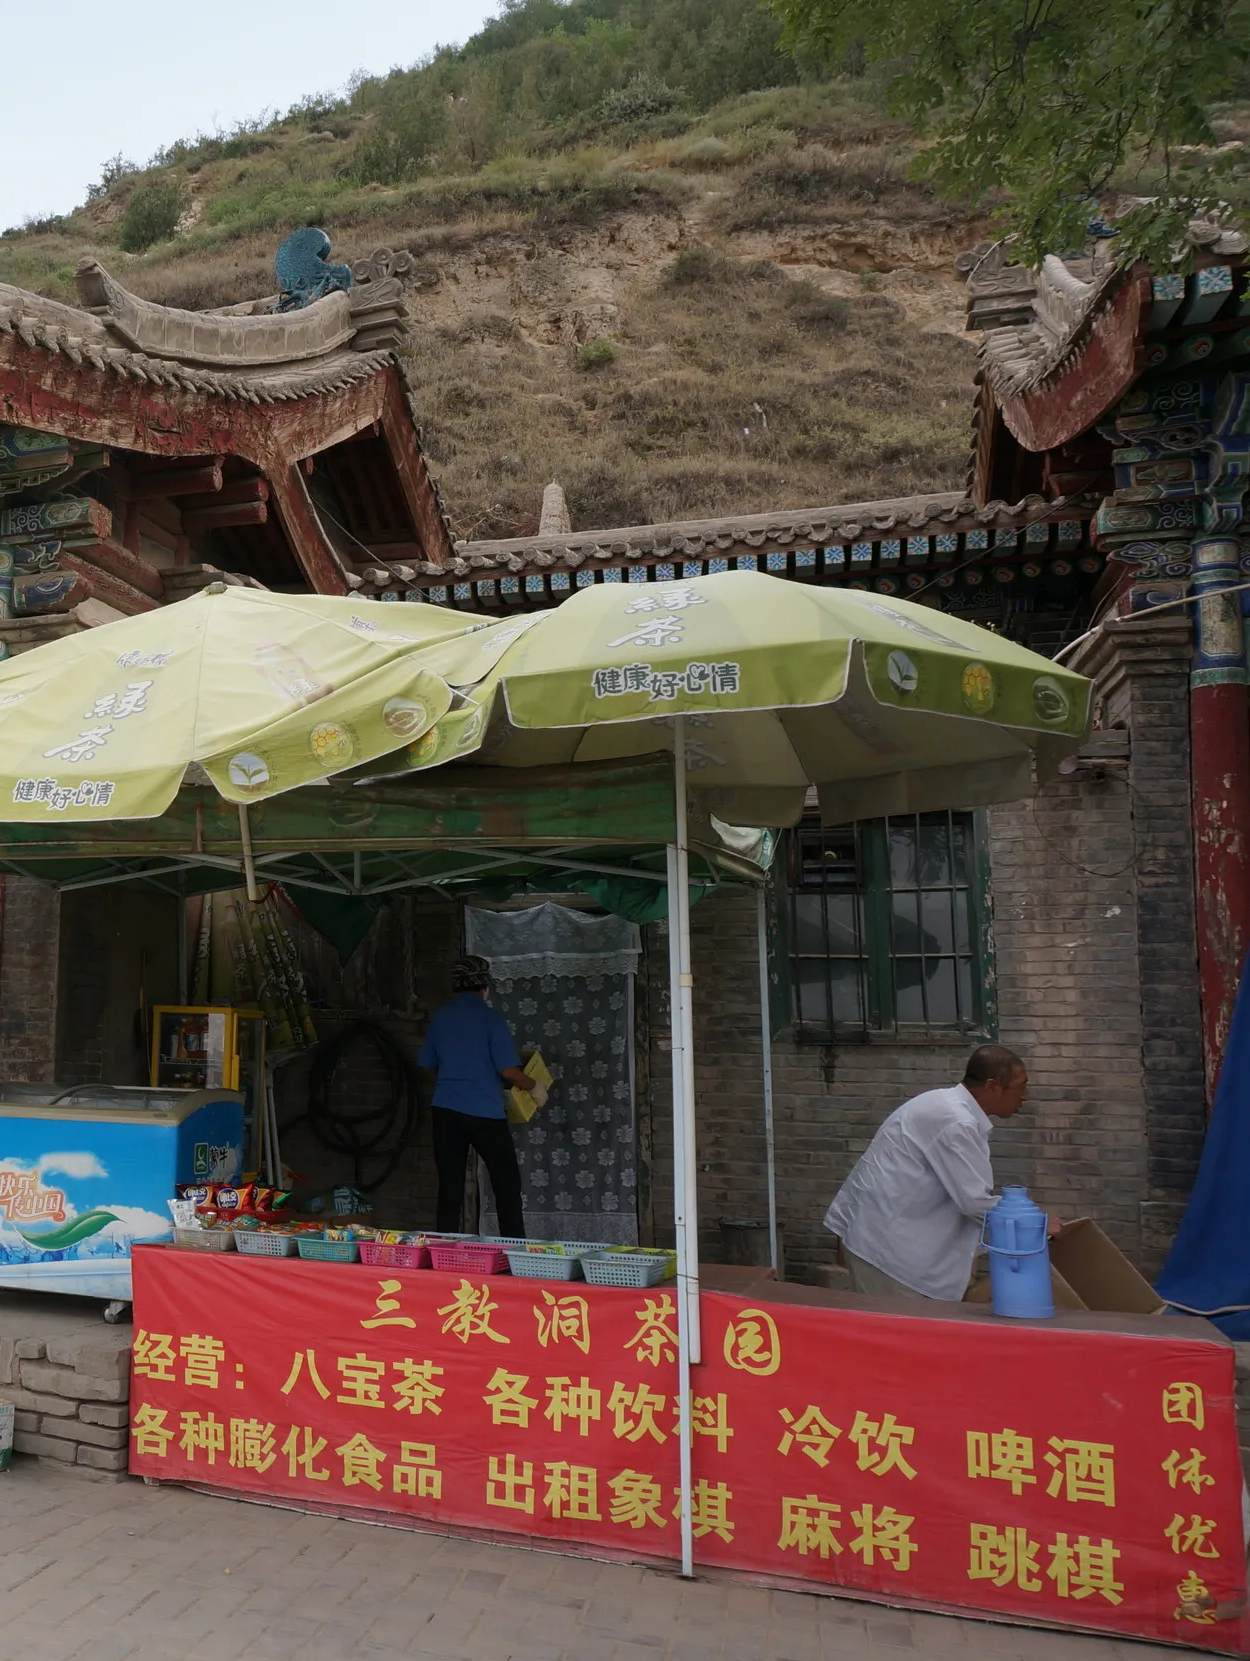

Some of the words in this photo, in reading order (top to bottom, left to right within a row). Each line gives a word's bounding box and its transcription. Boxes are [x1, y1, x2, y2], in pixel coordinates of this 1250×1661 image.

[592, 661, 741, 701] 健康好心情
[13, 779, 115, 811] 健康好心情
[360, 1279, 781, 1376] 三教洞茶园
[281, 1349, 446, 1415] 八宝茶
[483, 1367, 735, 1453] 各种饮料
[777, 1405, 918, 1480] 冷饮
[966, 1428, 1116, 1507] 啤酒
[131, 1403, 443, 1499] 各种膨化食品
[485, 1453, 735, 1544] 出租象棋
[777, 1494, 919, 1571] 麻将
[967, 1523, 1125, 1605] 跳棋
